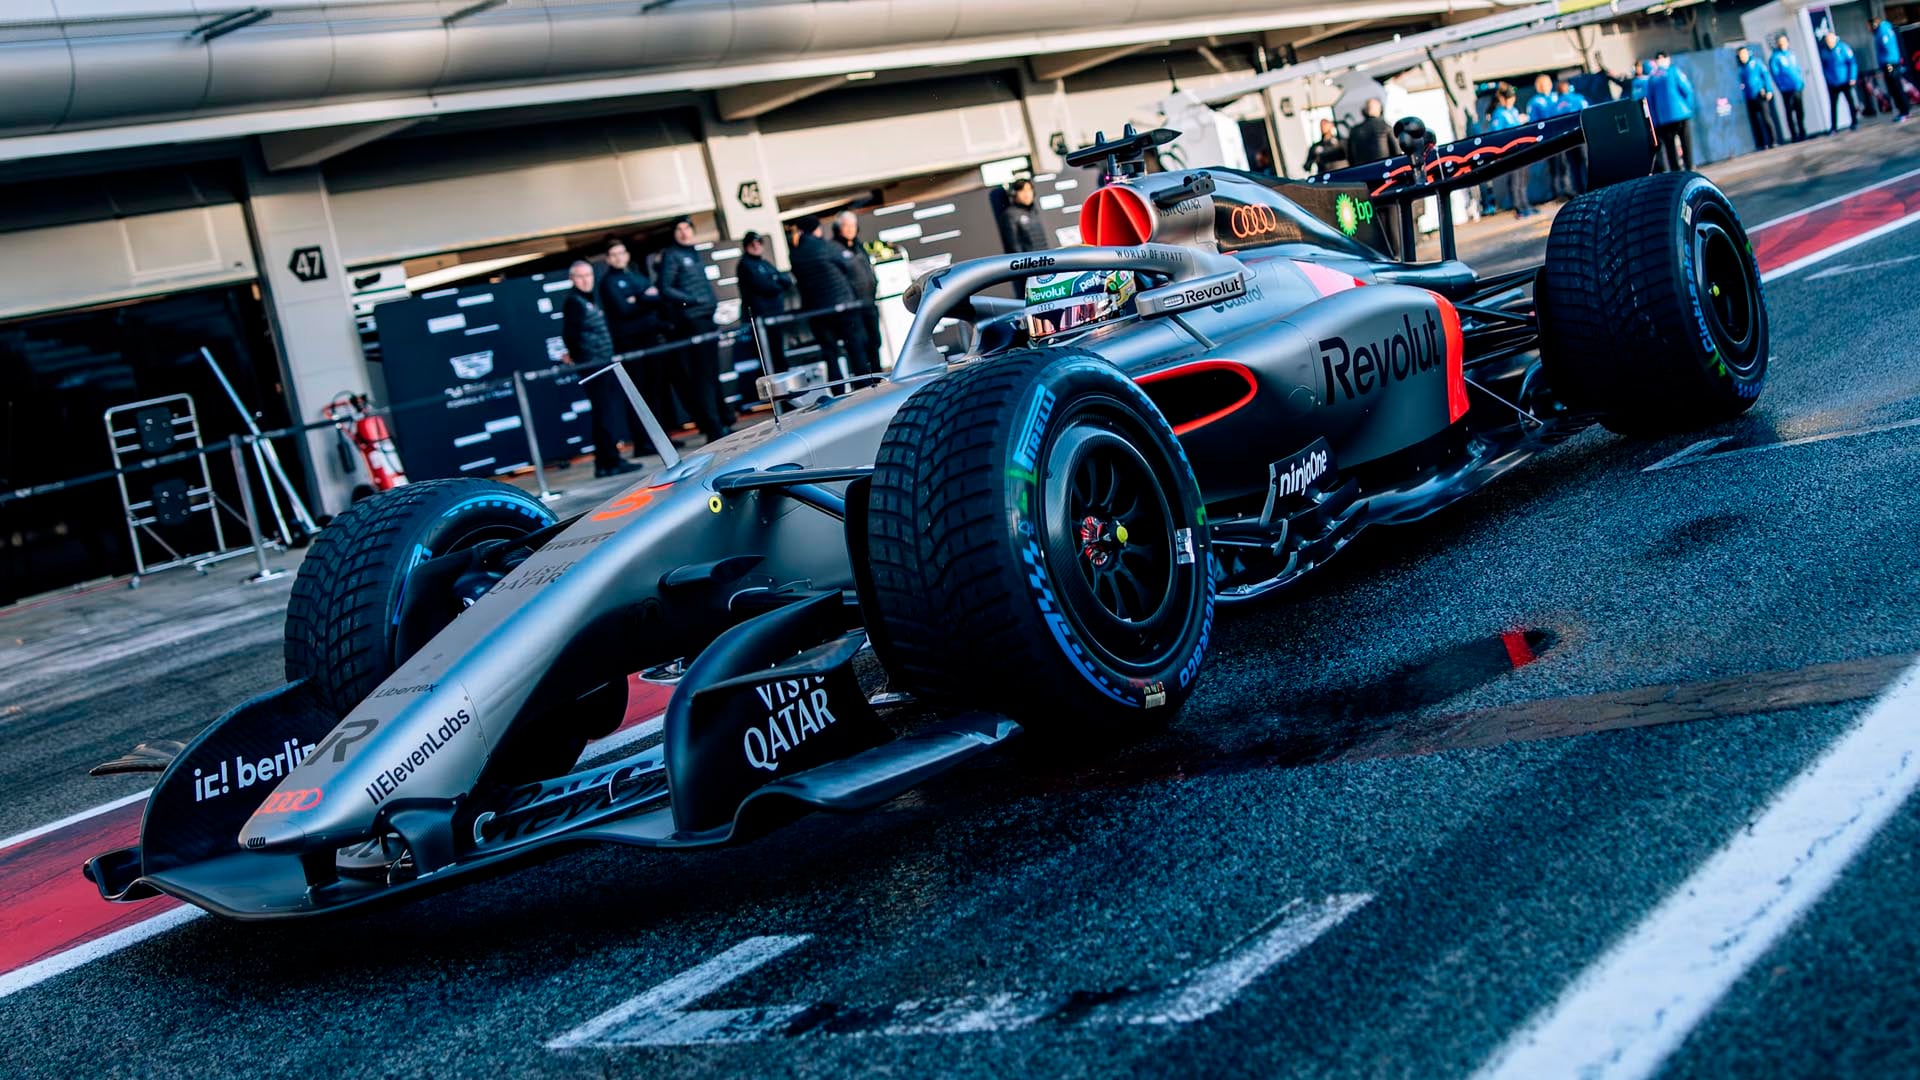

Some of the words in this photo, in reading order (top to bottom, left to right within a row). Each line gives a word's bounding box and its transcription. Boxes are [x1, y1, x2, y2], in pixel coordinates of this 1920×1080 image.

[1355, 200, 1373, 224] bp
[296, 251, 320, 277] 47
[1009, 256, 1056, 271] Gillette
[1115, 249, 1147, 259] WORLD
[1149, 250, 1159, 260] OF
[1160, 250, 1183, 262] HYATT
[1030, 286, 1066, 302] Revolut
[1185, 279, 1241, 304] Revolut
[1319, 309, 1441, 406] Revolut
[1012, 384, 1057, 473] PIRELLI
[1279, 449, 1328, 497] ninjaOne
[755, 676, 825, 711] VIS
[744, 688, 836, 771] QATAR
